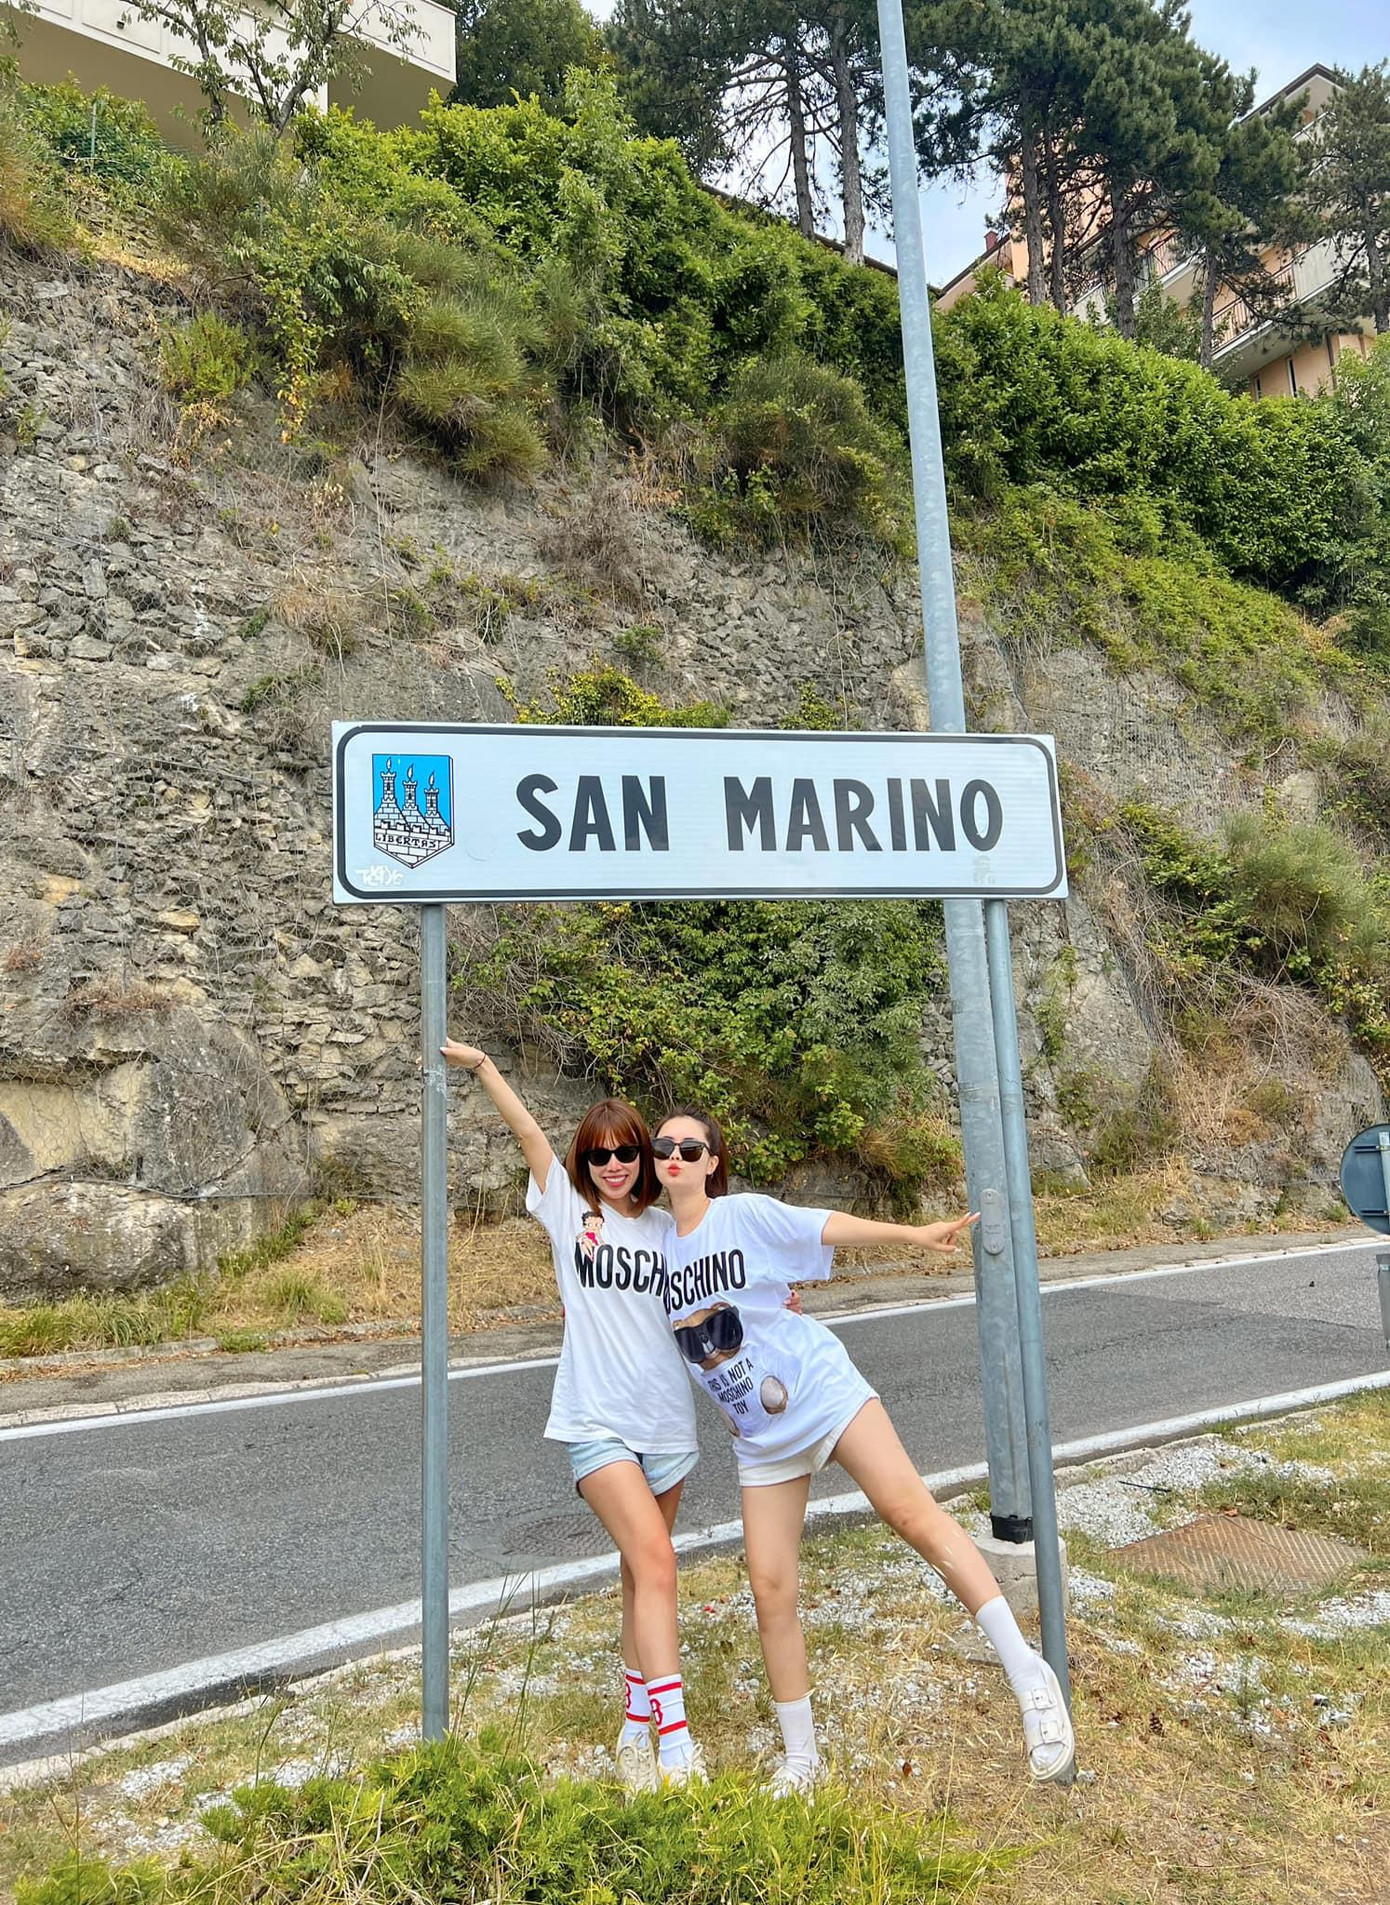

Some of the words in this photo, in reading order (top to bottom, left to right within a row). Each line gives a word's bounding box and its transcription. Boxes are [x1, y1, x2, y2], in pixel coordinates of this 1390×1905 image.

[517, 774, 669, 851] SAN
[724, 777, 1002, 851] MARINO
[375, 832, 437, 848] LIBERTAS
[728, 1361, 746, 1384] NOT
[745, 1357, 754, 1371] A
[717, 1376, 754, 1403] MOSCHINO
[732, 1399, 749, 1415] TOY
